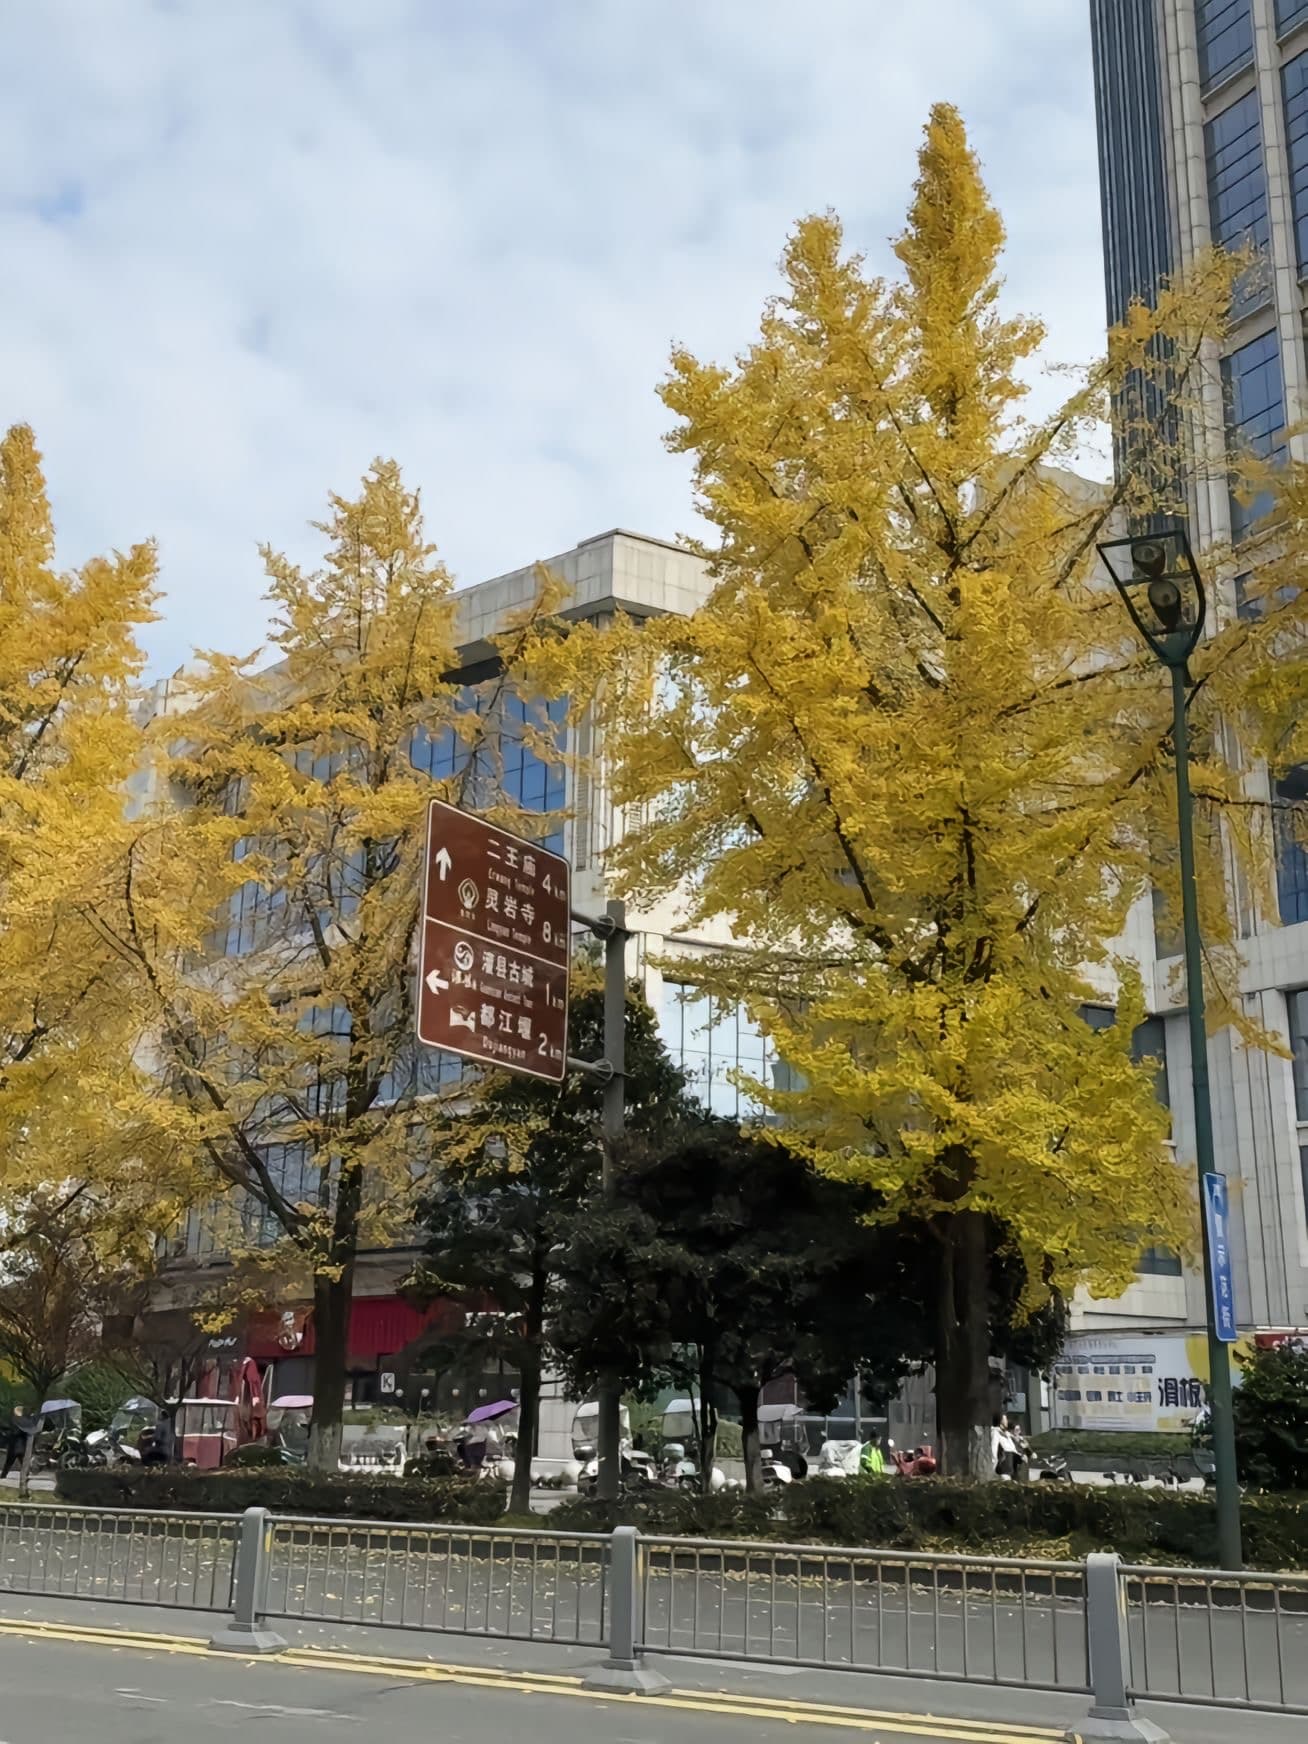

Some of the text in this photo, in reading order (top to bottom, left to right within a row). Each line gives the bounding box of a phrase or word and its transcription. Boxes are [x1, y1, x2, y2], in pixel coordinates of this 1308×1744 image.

[487, 839, 536, 877] 二王庙
[542, 873, 552, 896] 4
[485, 887, 535, 926] 灵岩寺
[542, 921, 552, 944] 8
[480, 1003, 532, 1040] 都江堰
[538, 1032, 548, 1056] 2
